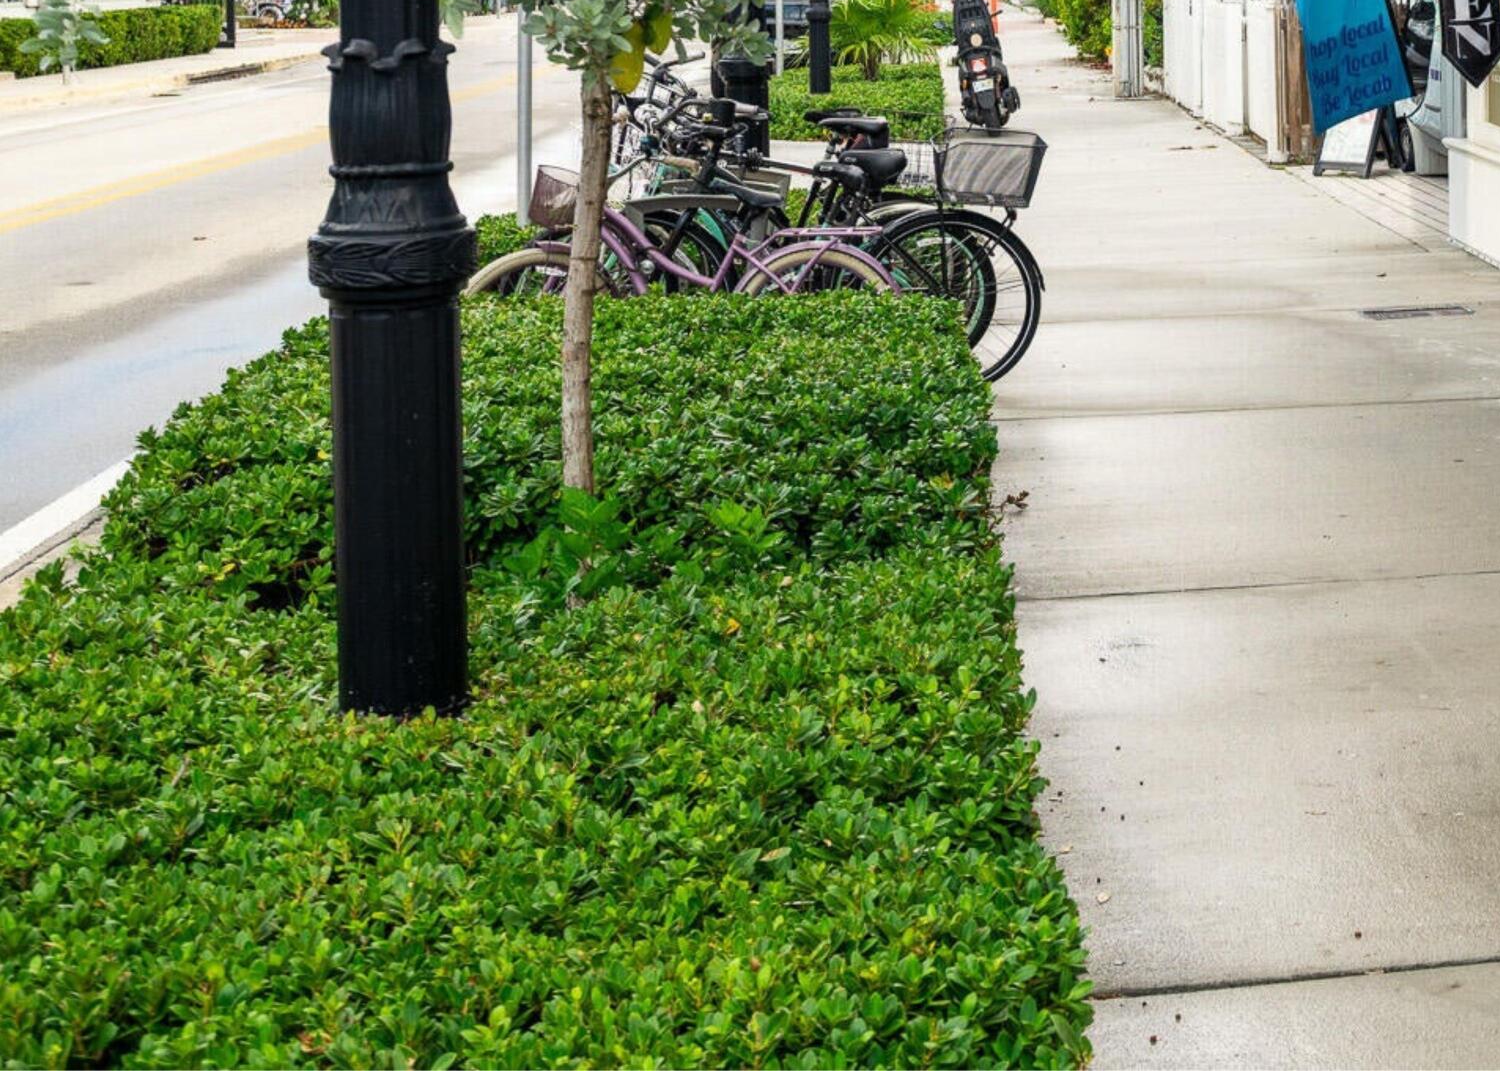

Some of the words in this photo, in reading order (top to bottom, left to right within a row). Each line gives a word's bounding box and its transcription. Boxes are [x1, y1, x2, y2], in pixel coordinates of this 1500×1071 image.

[1310, 36, 1338, 59] hop
[1342, 13, 1386, 49] Local
[1343, 42, 1389, 78] Local
